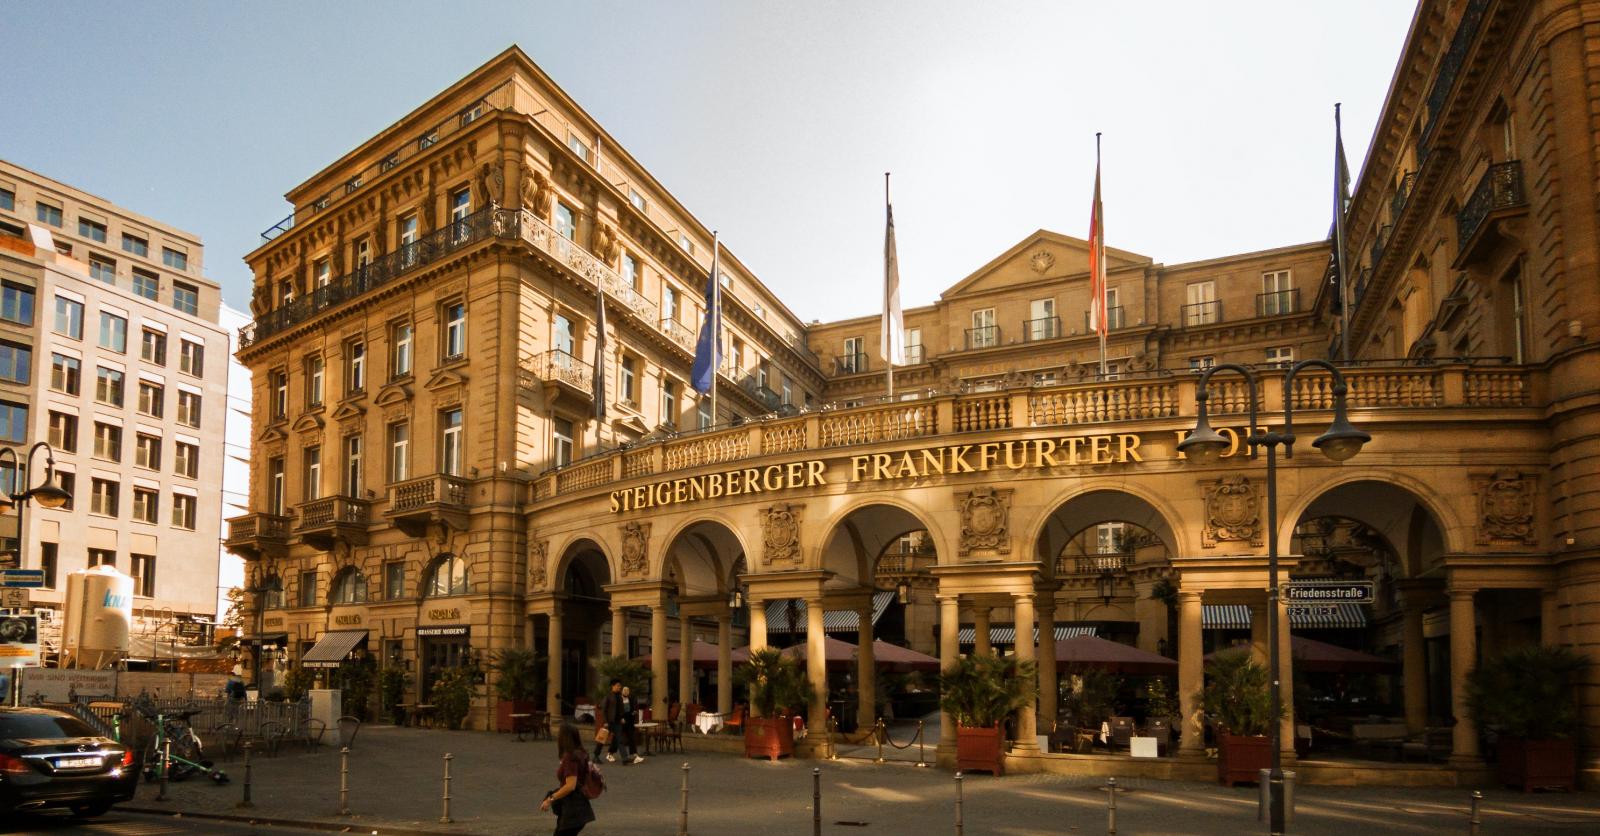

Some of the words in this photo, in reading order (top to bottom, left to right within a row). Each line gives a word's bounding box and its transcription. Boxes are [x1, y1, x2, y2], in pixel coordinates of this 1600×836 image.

[609, 460, 827, 513] STEIGENBERGER
[851, 434, 1144, 482] FRANKFURTER
[1290, 587, 1363, 598] Friedensstraße
